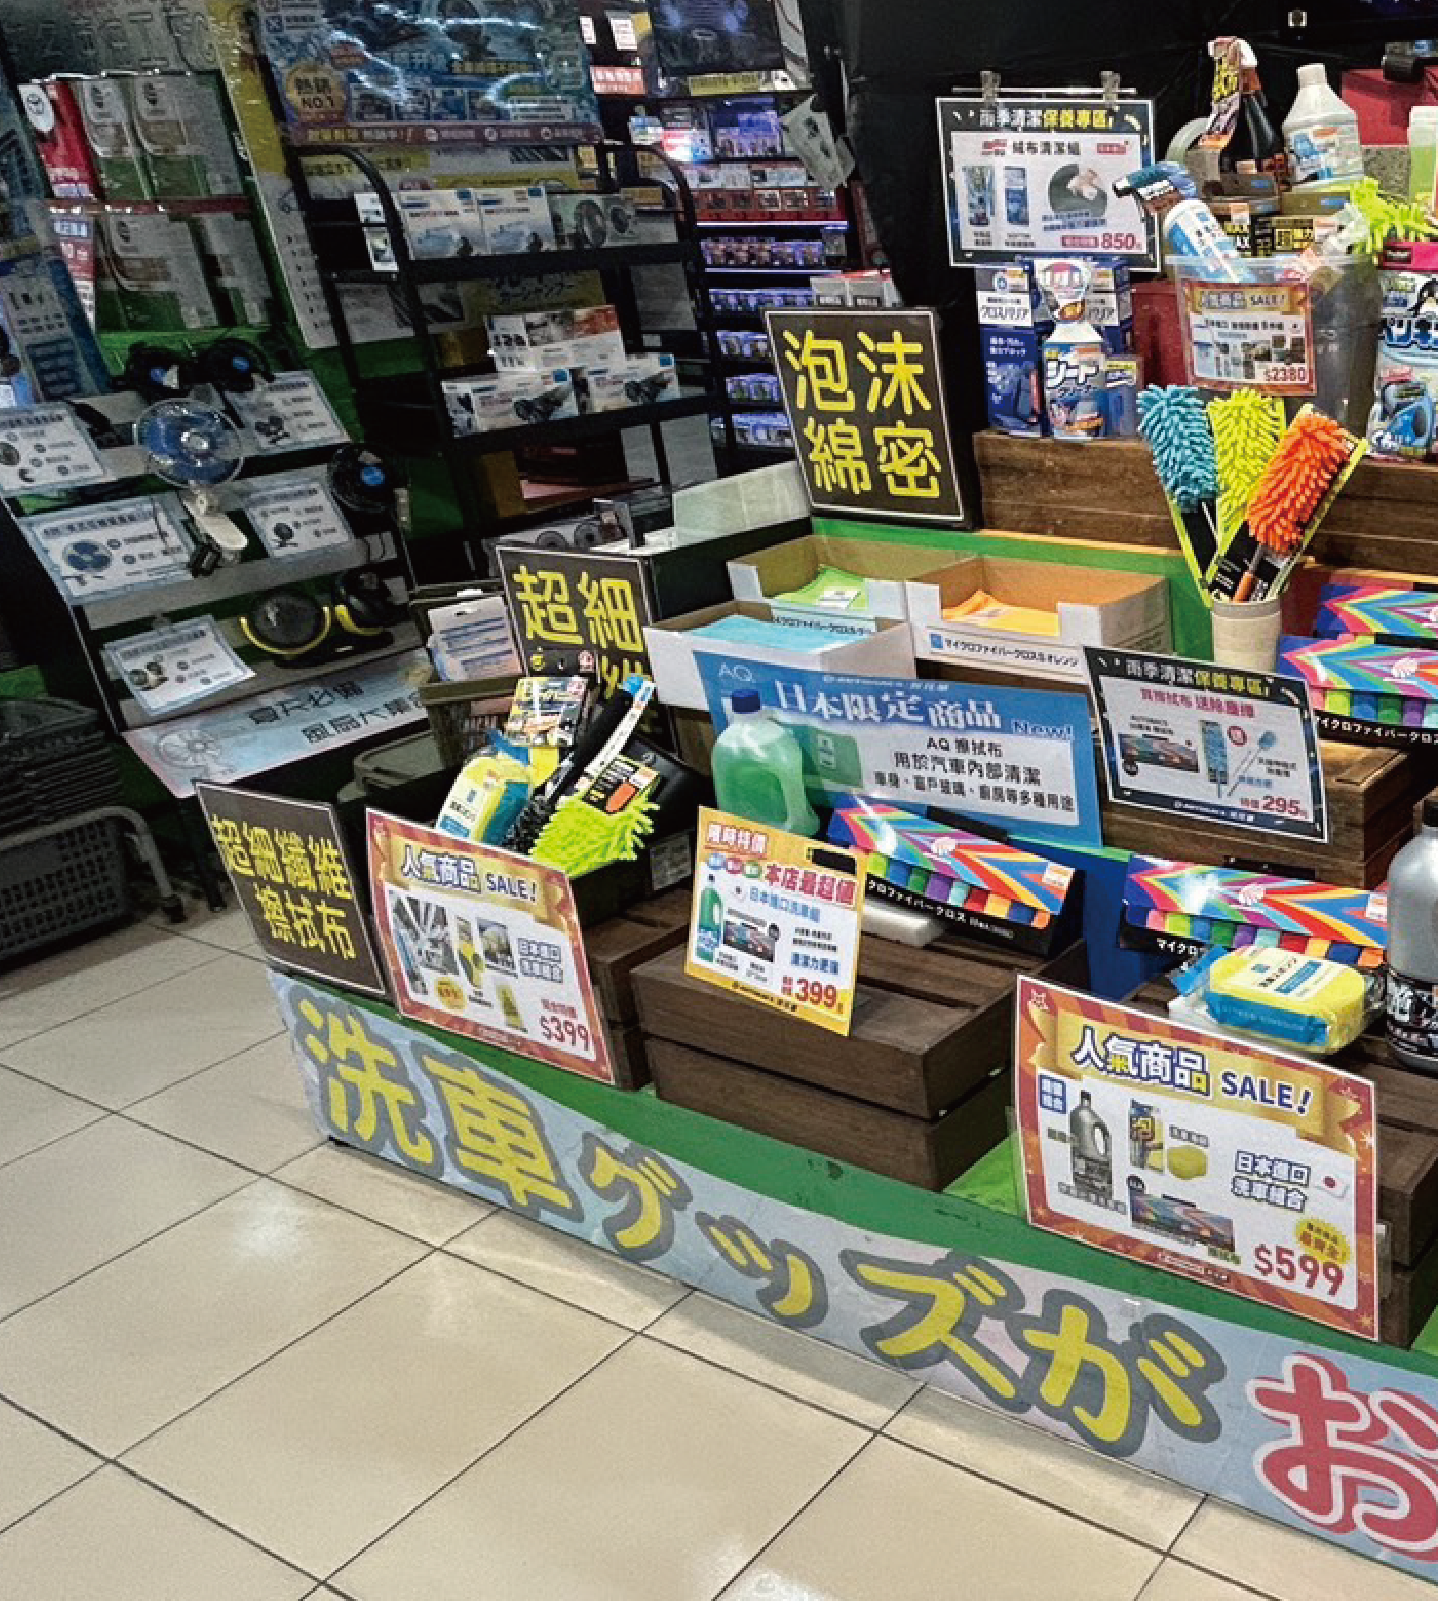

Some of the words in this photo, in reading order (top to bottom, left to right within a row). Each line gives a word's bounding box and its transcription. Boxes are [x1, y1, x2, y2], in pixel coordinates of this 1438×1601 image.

[782, 329, 932, 415] 泡沫
[803, 416, 941, 498] 綿密
[512, 564, 643, 652] 超細
[717, 664, 754, 683] AQ
[775, 679, 1002, 729] 日本限定商品
[1262, 796, 1300, 816] 295
[211, 813, 352, 900] 超細纖維
[402, 844, 482, 894] 人氣商品
[486, 872, 537, 902] SALE!
[253, 881, 356, 960] 擦拭布
[795, 977, 837, 1009] 399
[539, 1016, 588, 1051] $399
[1070, 1024, 1211, 1097] 人氣商品
[1221, 1072, 1312, 1115] SALE!
[1231, 1175, 1308, 1213] 洗車組合
[1235, 1150, 1311, 1188] 日本進口
[1253, 1244, 1344, 1297] $599
